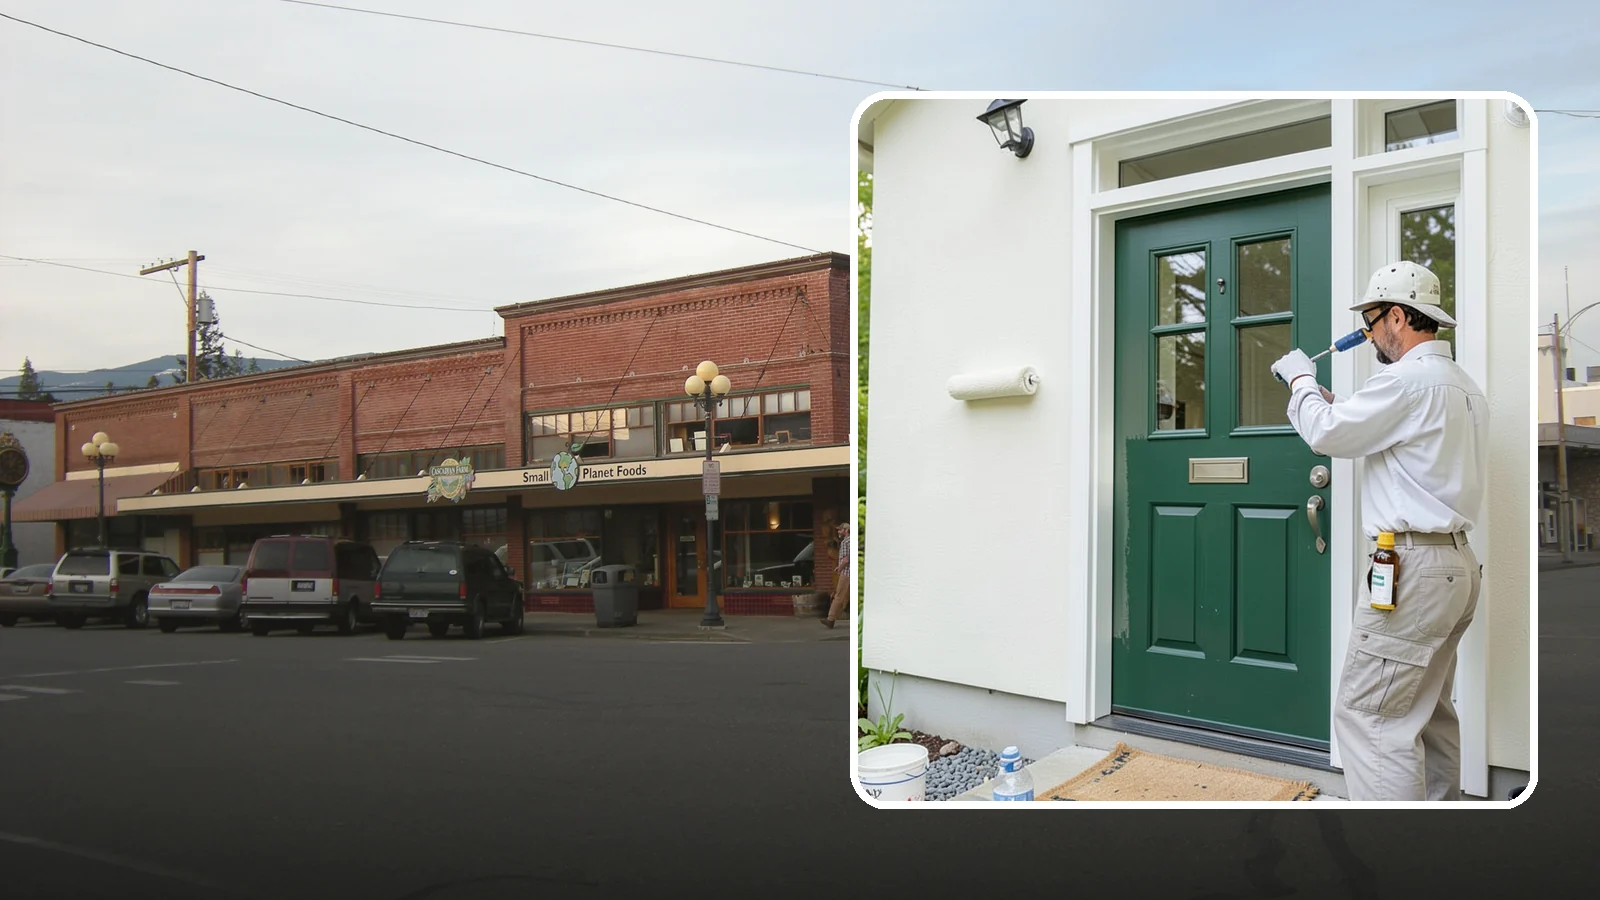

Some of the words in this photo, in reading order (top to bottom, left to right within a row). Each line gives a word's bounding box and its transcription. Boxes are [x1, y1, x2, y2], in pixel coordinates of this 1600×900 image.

[523, 471, 549, 483] Small
[583, 467, 614, 479] Planet
[617, 464, 647, 477] Foods
